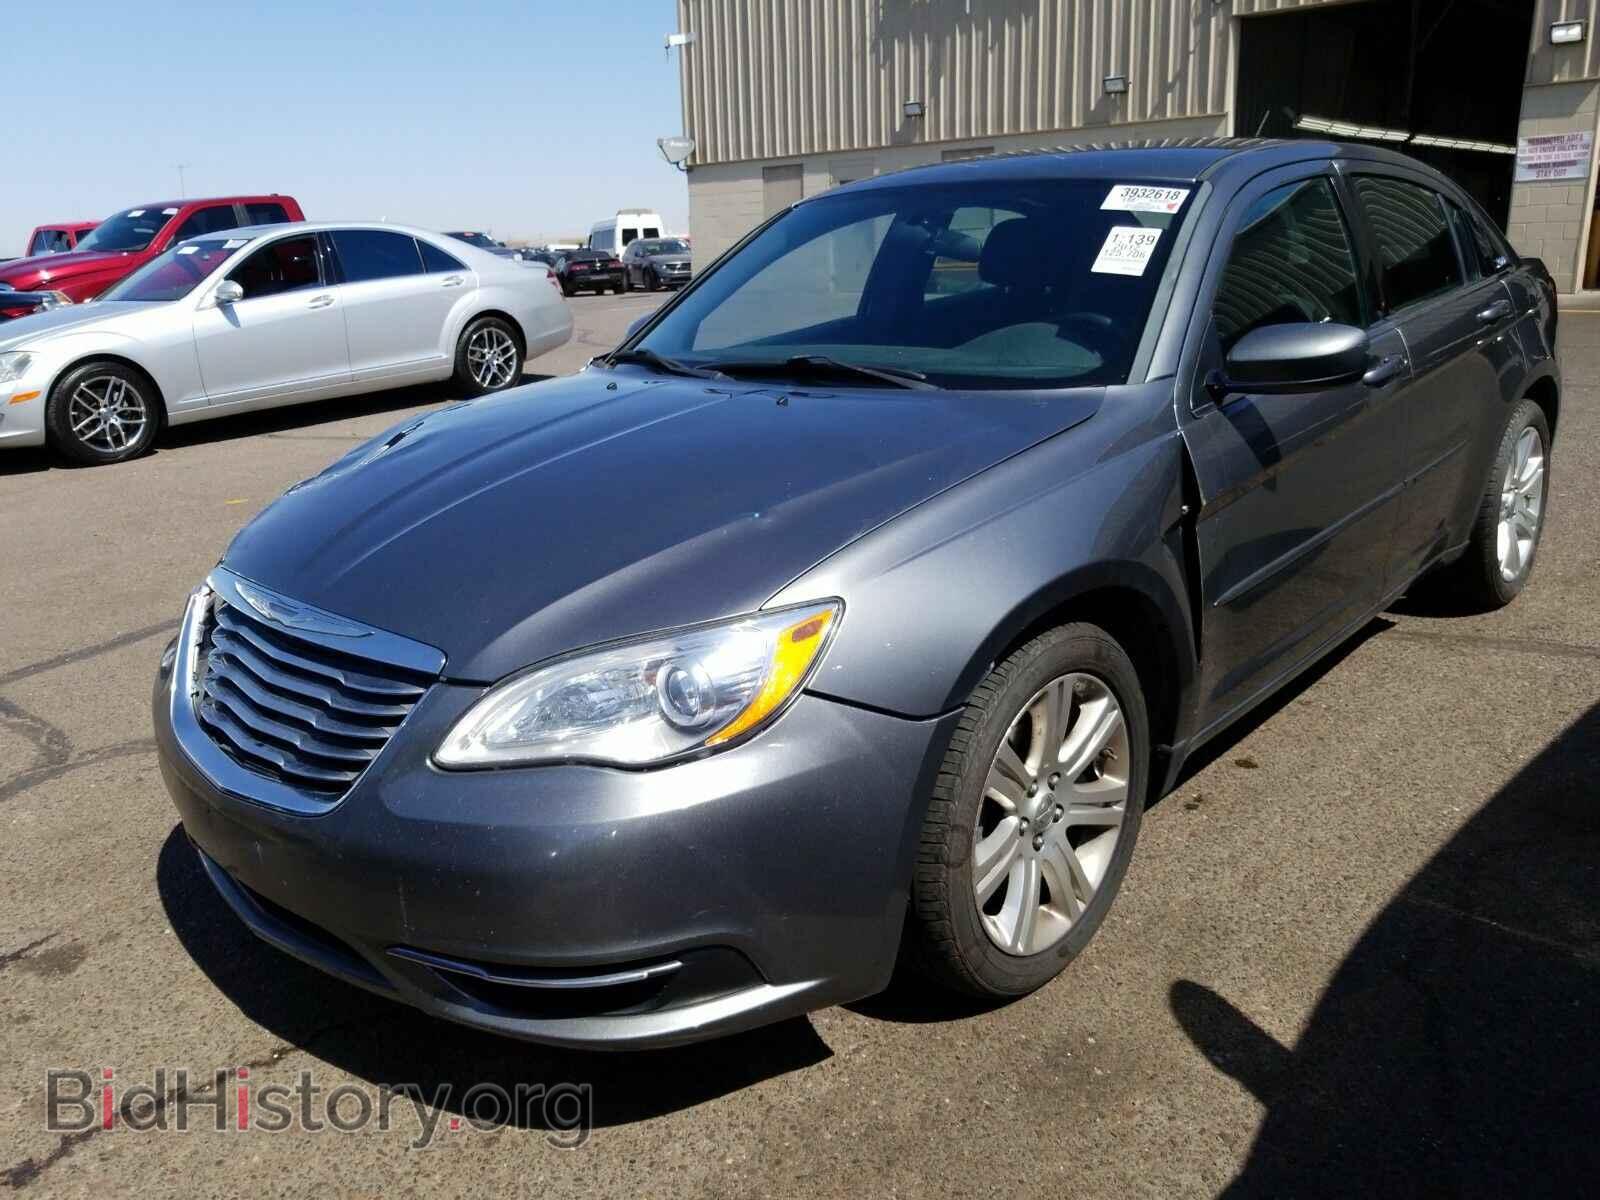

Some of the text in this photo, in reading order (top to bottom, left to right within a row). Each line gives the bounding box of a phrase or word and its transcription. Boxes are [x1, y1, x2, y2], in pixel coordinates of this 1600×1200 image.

[1536, 168, 1567, 178] STAY OUT
[1120, 187, 1181, 201] 3932618
